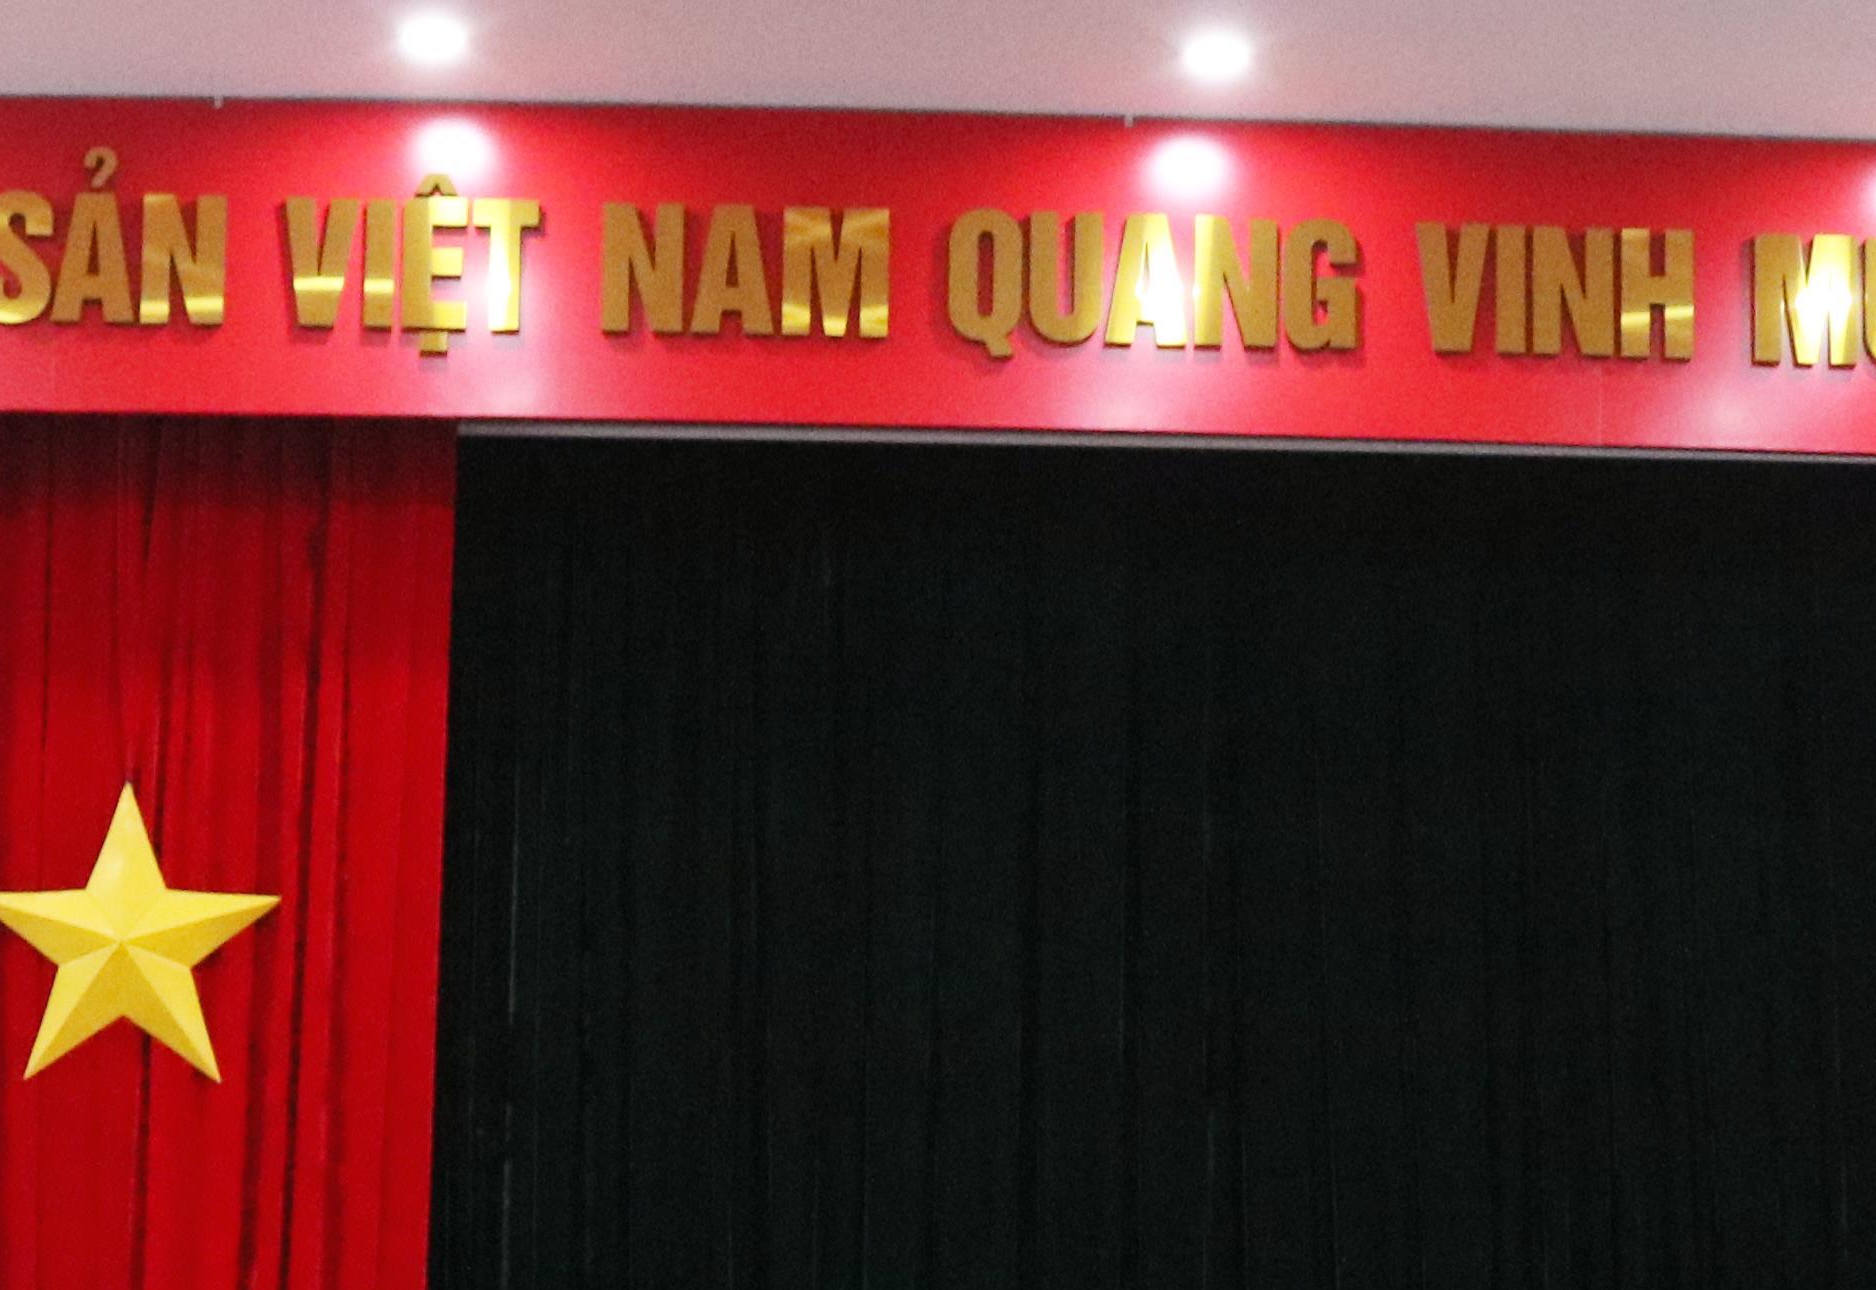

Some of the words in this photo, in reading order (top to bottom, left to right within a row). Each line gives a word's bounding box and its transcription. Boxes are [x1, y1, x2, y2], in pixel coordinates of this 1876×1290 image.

[282, 175, 543, 353] VIỆT
[600, 202, 890, 338] NAM
[946, 208, 1361, 357] QUANG
[1415, 221, 1696, 359] VINH
